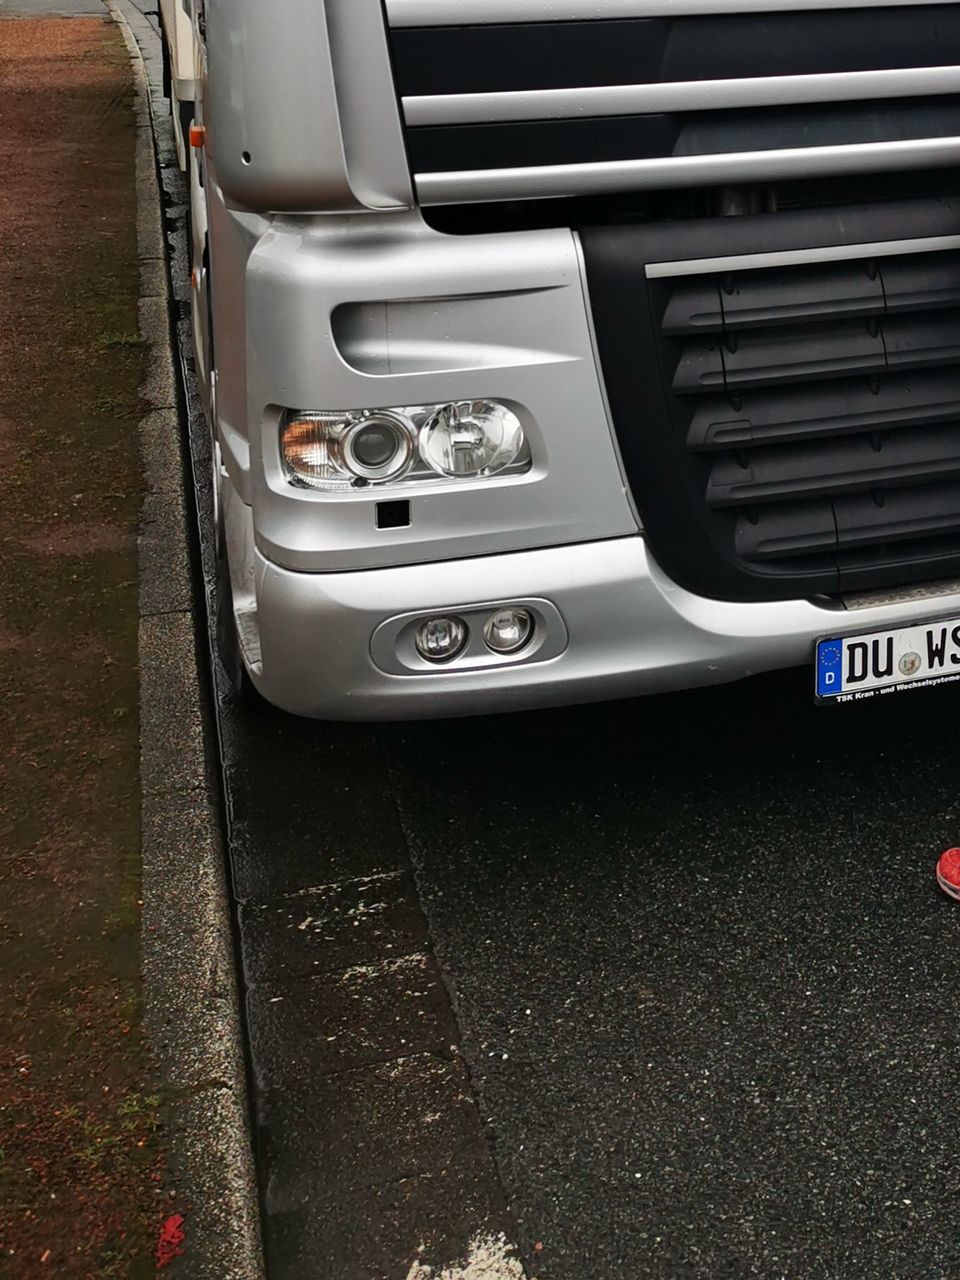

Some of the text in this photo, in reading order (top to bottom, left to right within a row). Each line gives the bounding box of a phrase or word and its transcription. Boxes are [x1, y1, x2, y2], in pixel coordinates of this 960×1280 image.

[846, 636, 893, 684] DU
[825, 672, 835, 685] D
[836, 695, 854, 703] TSK
[855, 690, 874, 700] Kran
[880, 686, 895, 695] und
